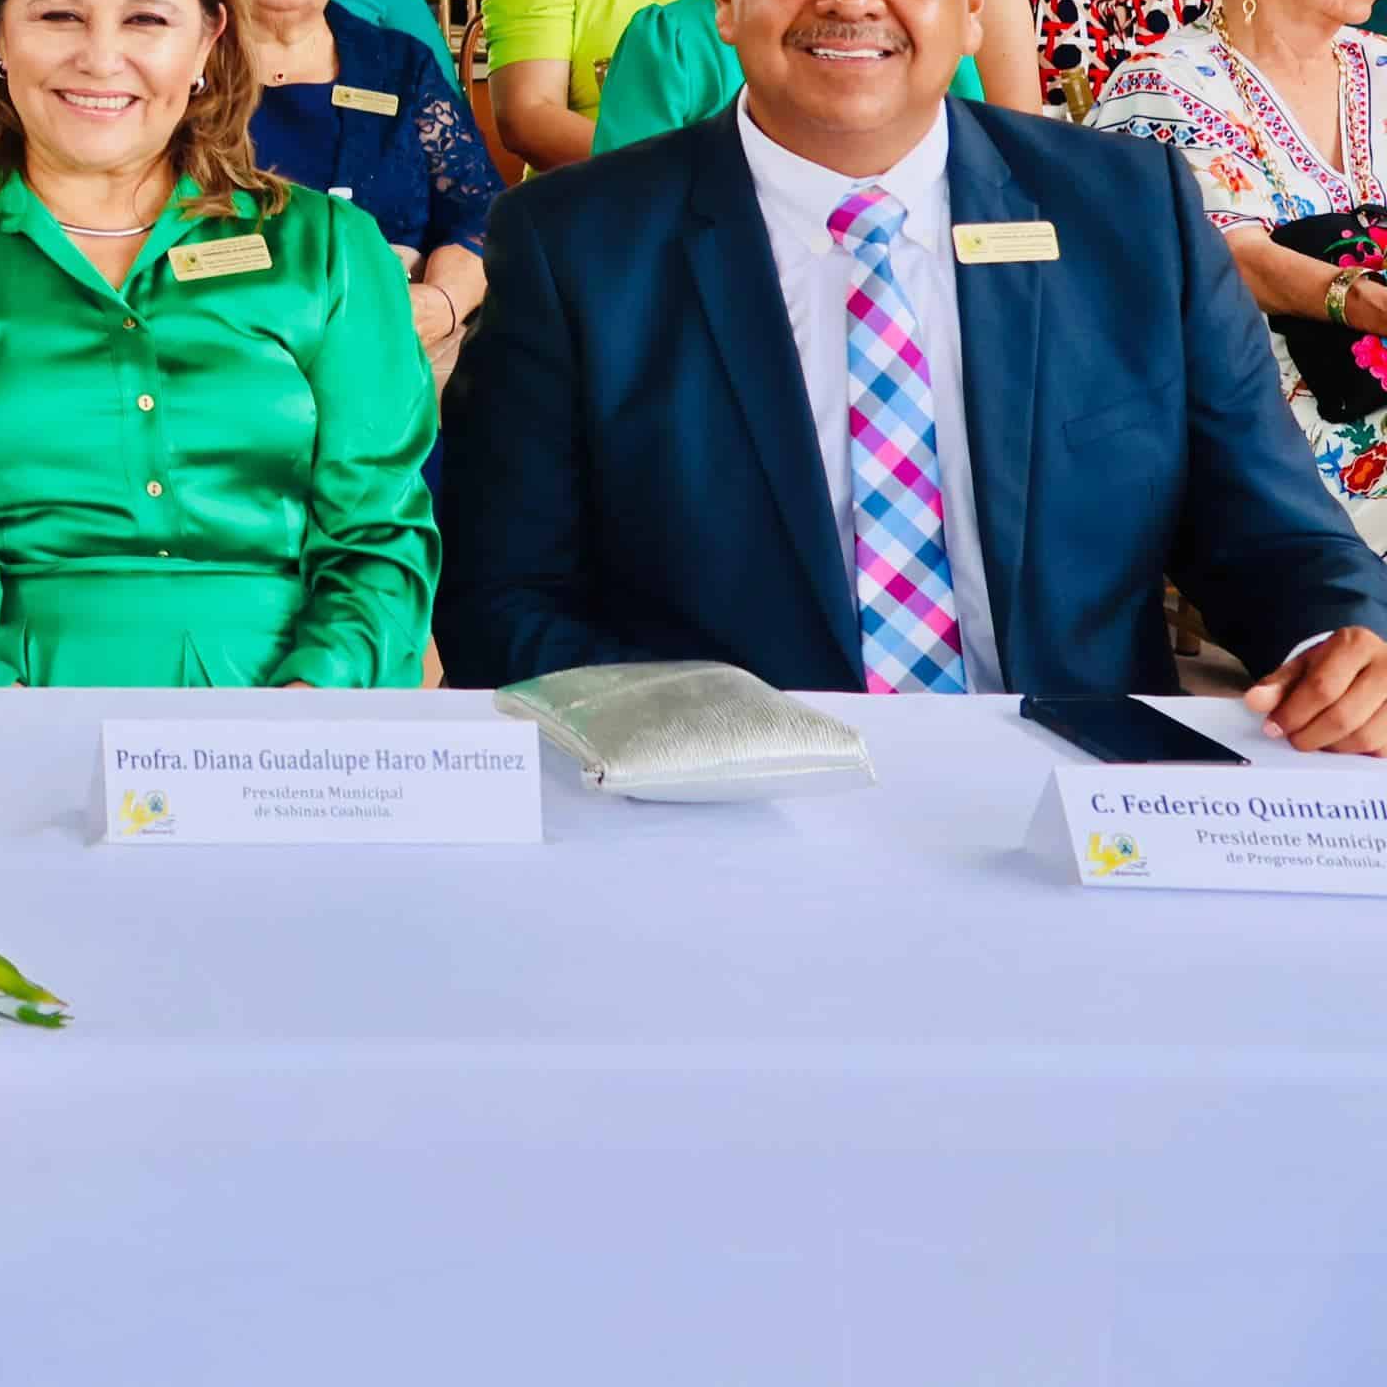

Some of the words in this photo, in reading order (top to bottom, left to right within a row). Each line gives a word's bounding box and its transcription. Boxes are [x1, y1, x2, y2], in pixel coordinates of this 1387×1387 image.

[116, 748, 188, 771] Profra.
[194, 749, 253, 771] Diana
[259, 748, 371, 776] Guadalupe
[376, 749, 426, 771] Haro
[242, 786, 324, 800] Presidenta
[327, 786, 403, 801] Municipal
[1091, 794, 1115, 814] C.
[1122, 794, 1241, 817] Federico
[1248, 797, 1387, 822] Quintanill
[1197, 829, 1302, 847] Presidente
[1307, 832, 1387, 854] Municip
[1226, 852, 1244, 864] de
[1247, 853, 1314, 868] Progreso
